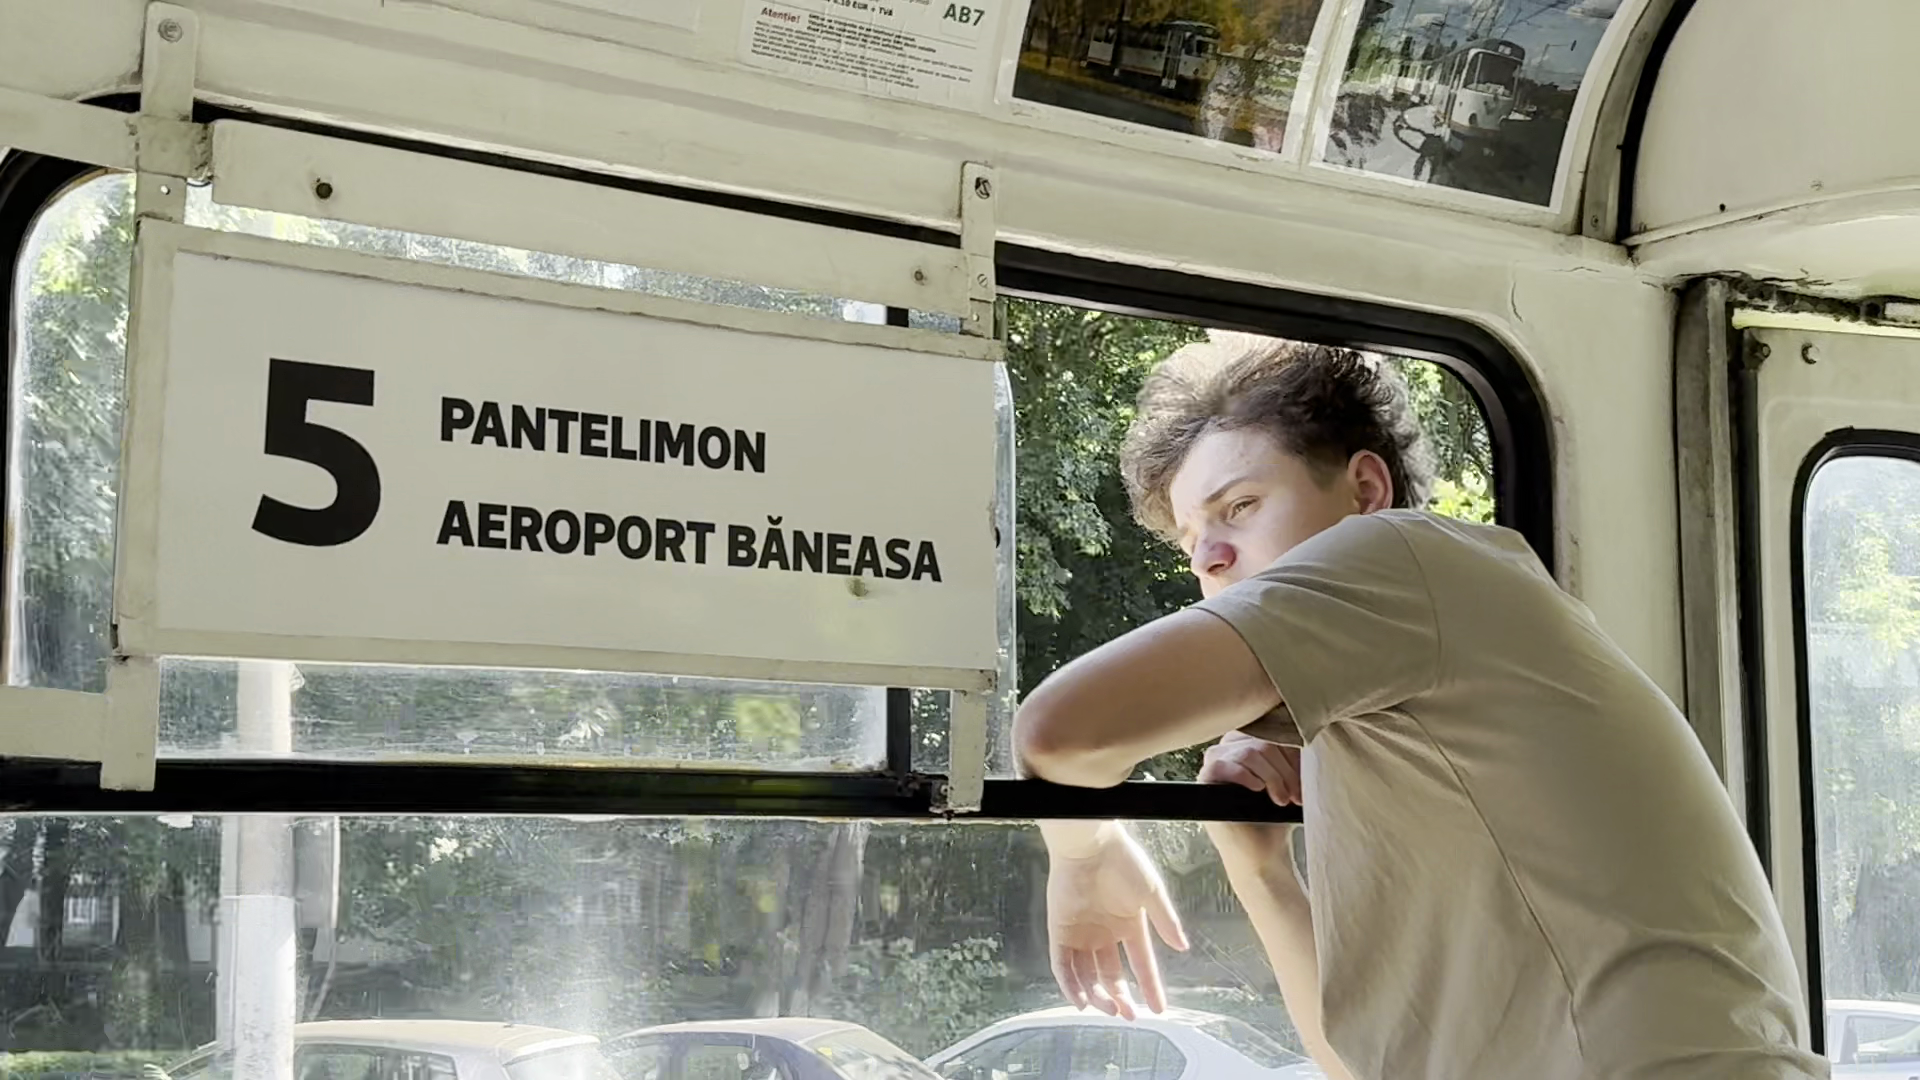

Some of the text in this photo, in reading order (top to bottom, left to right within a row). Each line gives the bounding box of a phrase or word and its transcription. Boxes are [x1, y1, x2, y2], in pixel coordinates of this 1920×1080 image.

[852, 1, 868, 10] EUR
[942, 3, 985, 27] AB7
[252, 358, 381, 547] 5
[441, 397, 766, 474] PANTELIMON
[437, 500, 943, 582] AEROPORT BĂNEASA
